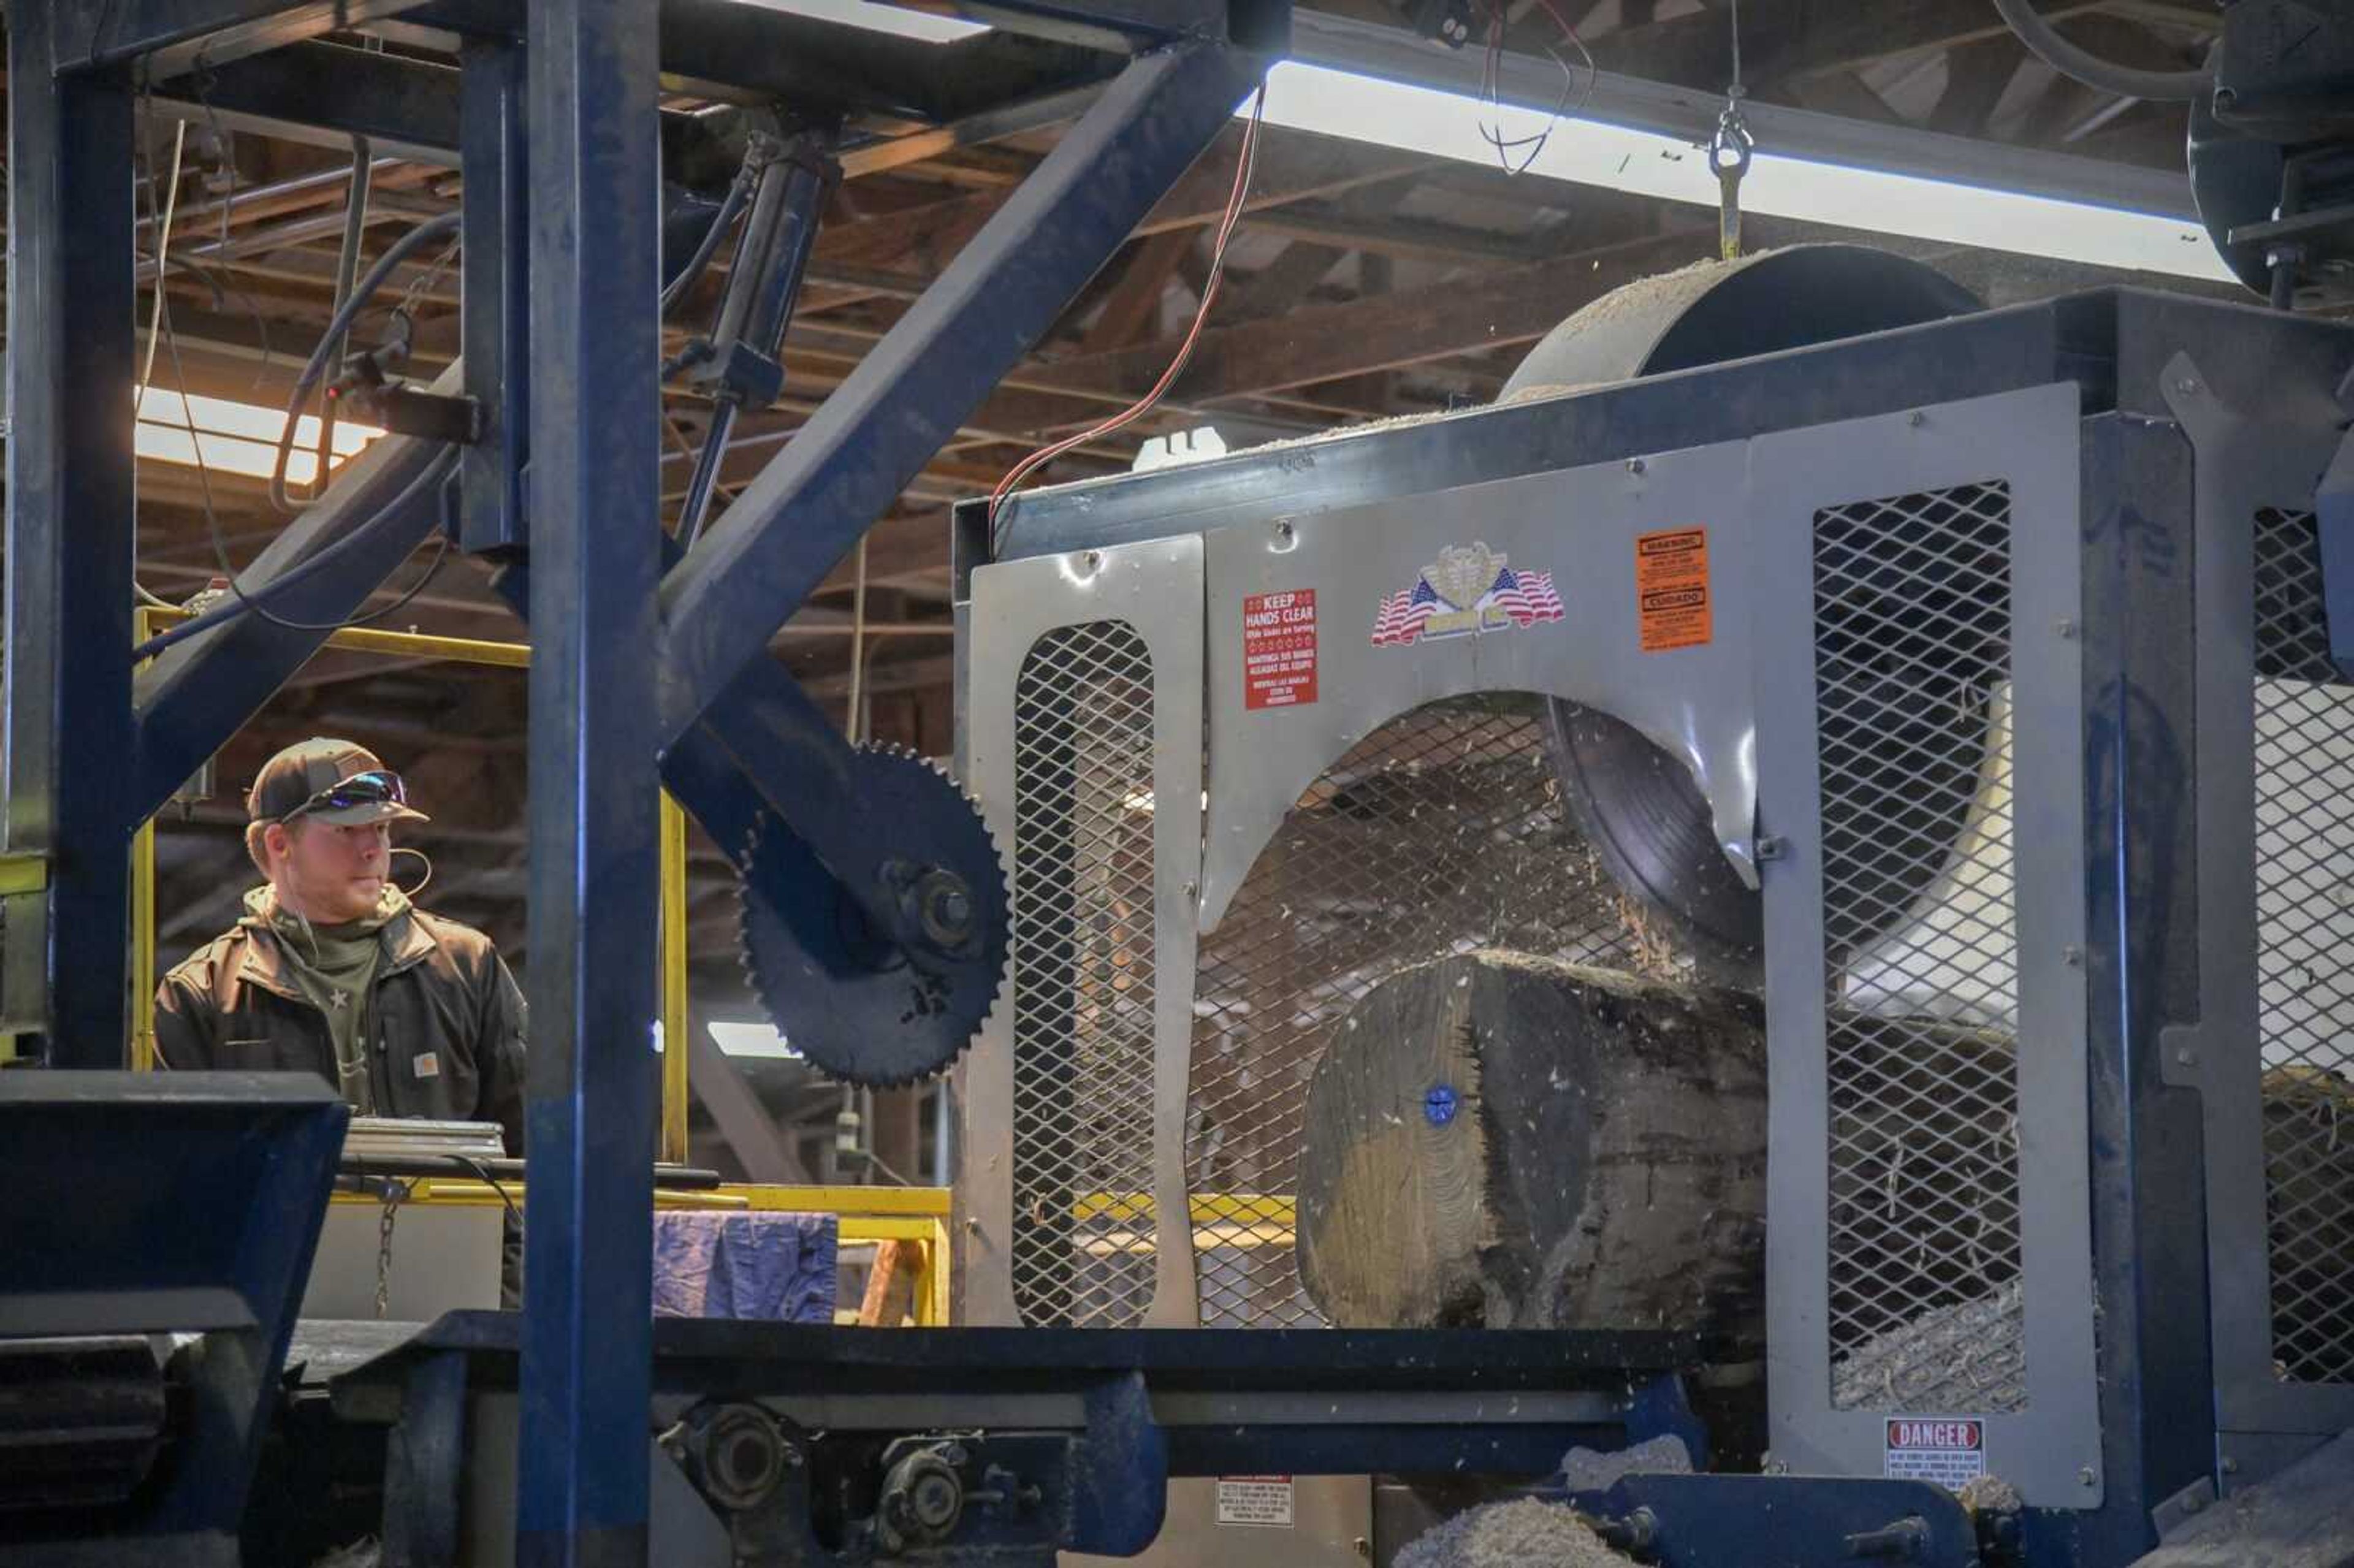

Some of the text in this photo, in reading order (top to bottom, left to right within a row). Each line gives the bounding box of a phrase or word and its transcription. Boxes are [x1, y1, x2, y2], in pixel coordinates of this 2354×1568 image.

[1263, 594, 1295, 609] KEEP
[1246, 606, 1314, 626] HANDS CLEAR
[1900, 1423, 1969, 1447] DANGER
